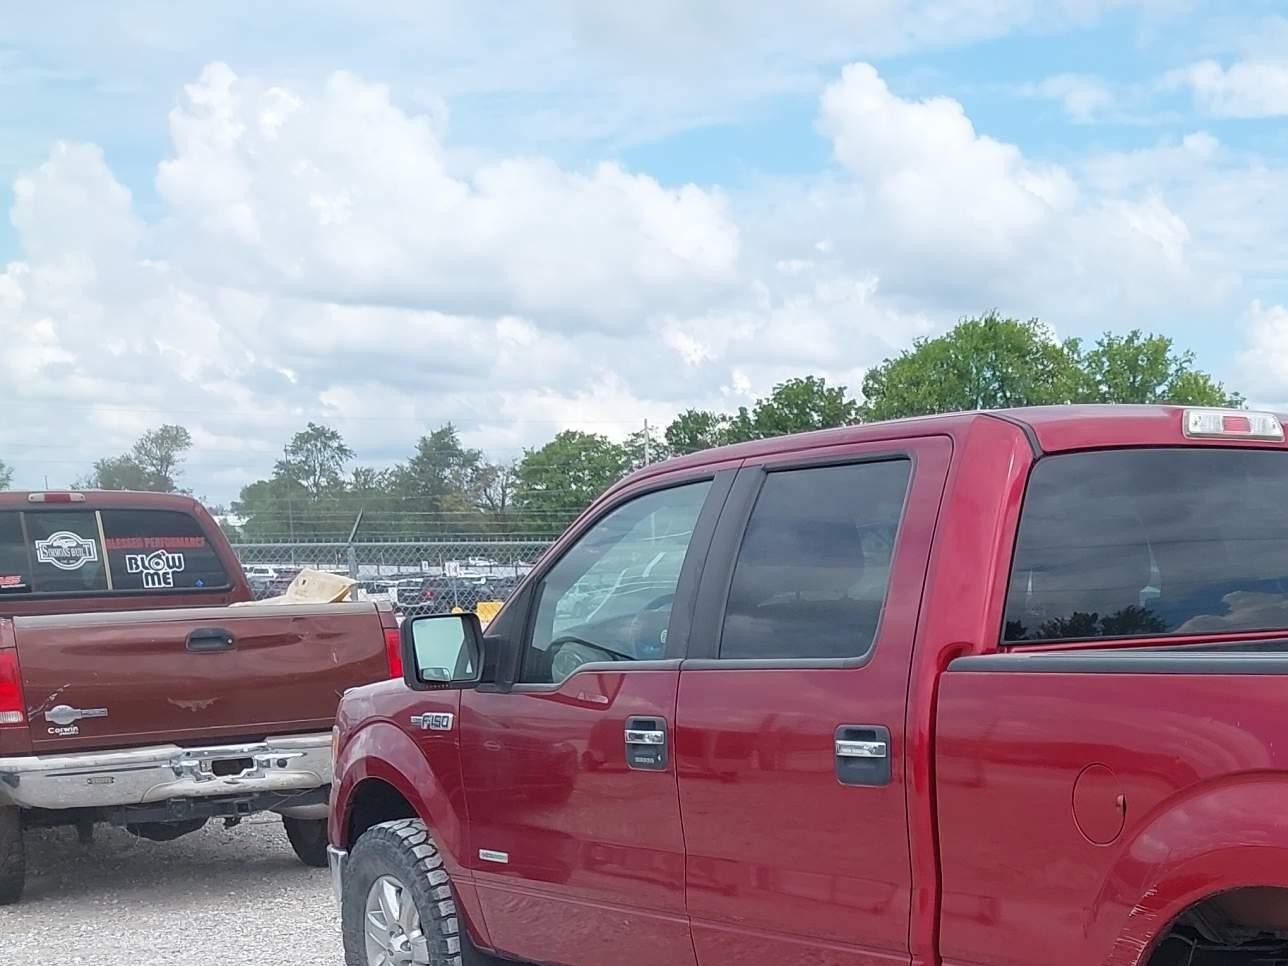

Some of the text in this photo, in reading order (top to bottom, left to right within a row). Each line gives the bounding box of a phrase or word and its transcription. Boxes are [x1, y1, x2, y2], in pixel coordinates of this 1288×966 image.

[127, 551, 183, 572] BLOW
[144, 571, 173, 587] ME
[48, 724, 79, 734] Corwin
